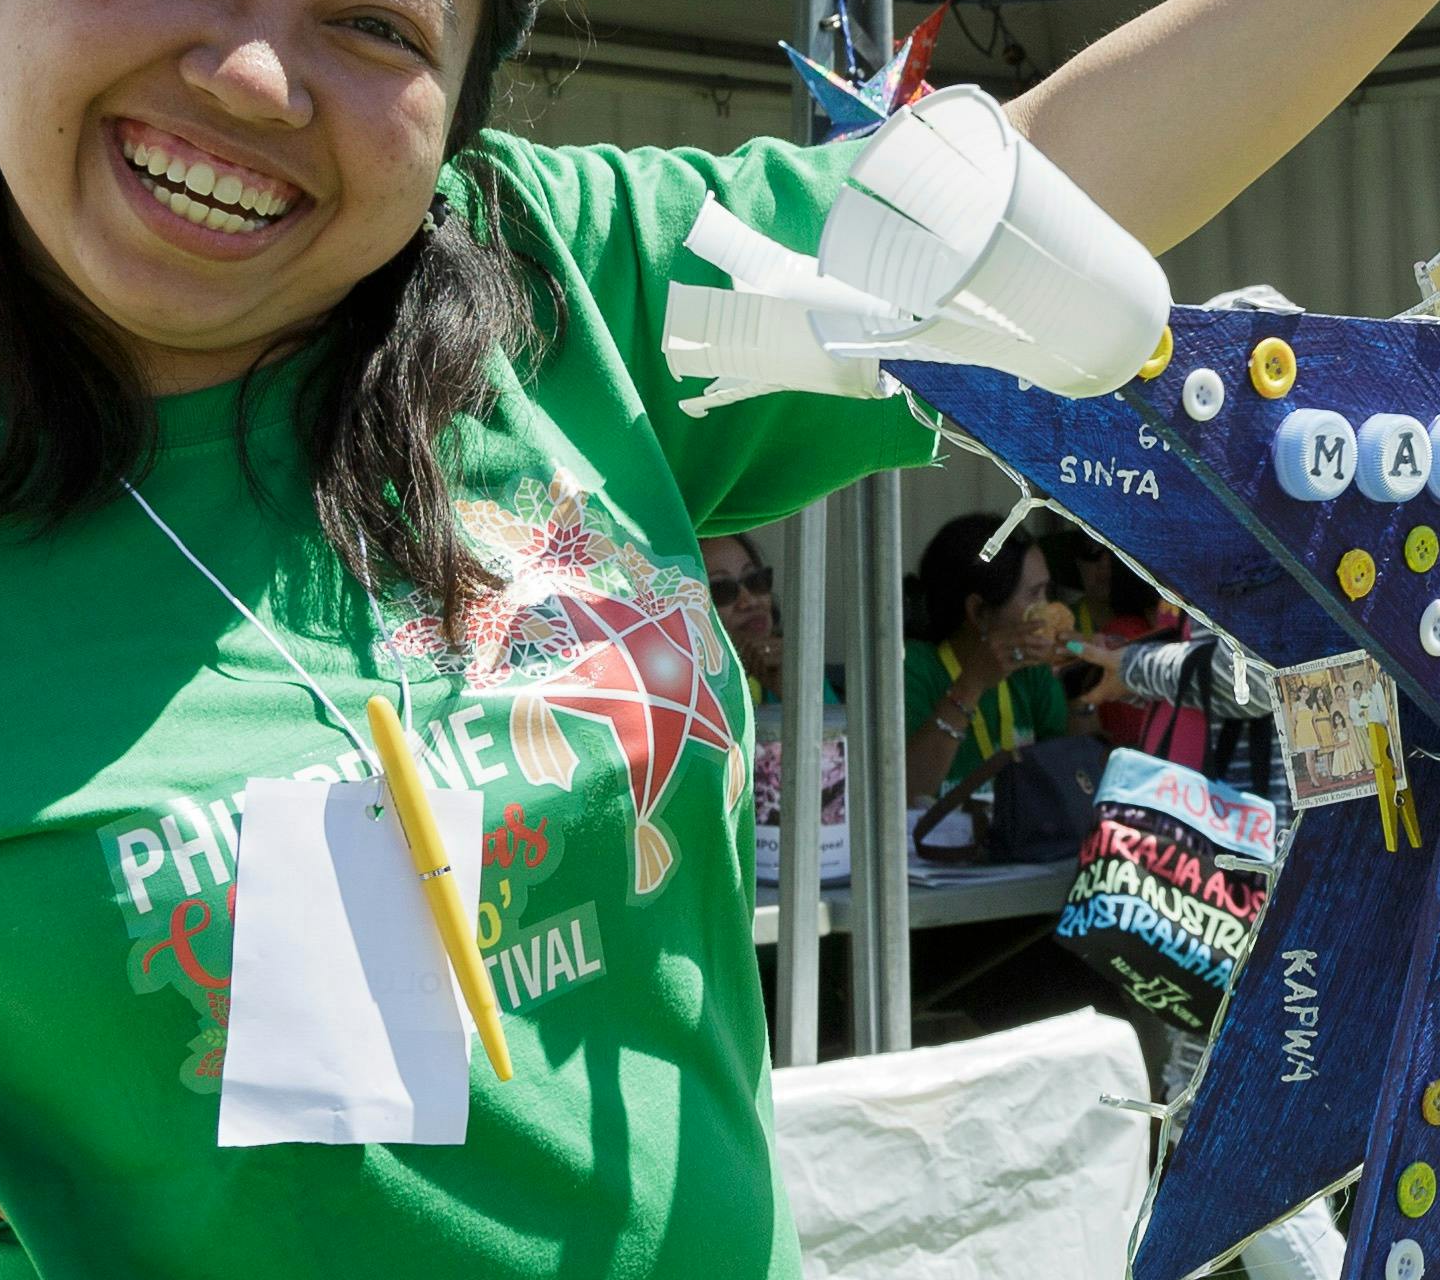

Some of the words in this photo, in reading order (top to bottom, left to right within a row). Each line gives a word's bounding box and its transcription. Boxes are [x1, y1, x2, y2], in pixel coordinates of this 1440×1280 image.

[1060, 455, 1159, 500] SINTA
[1313, 794, 1329, 804] you
[1281, 949, 1319, 1082] KAPWA
